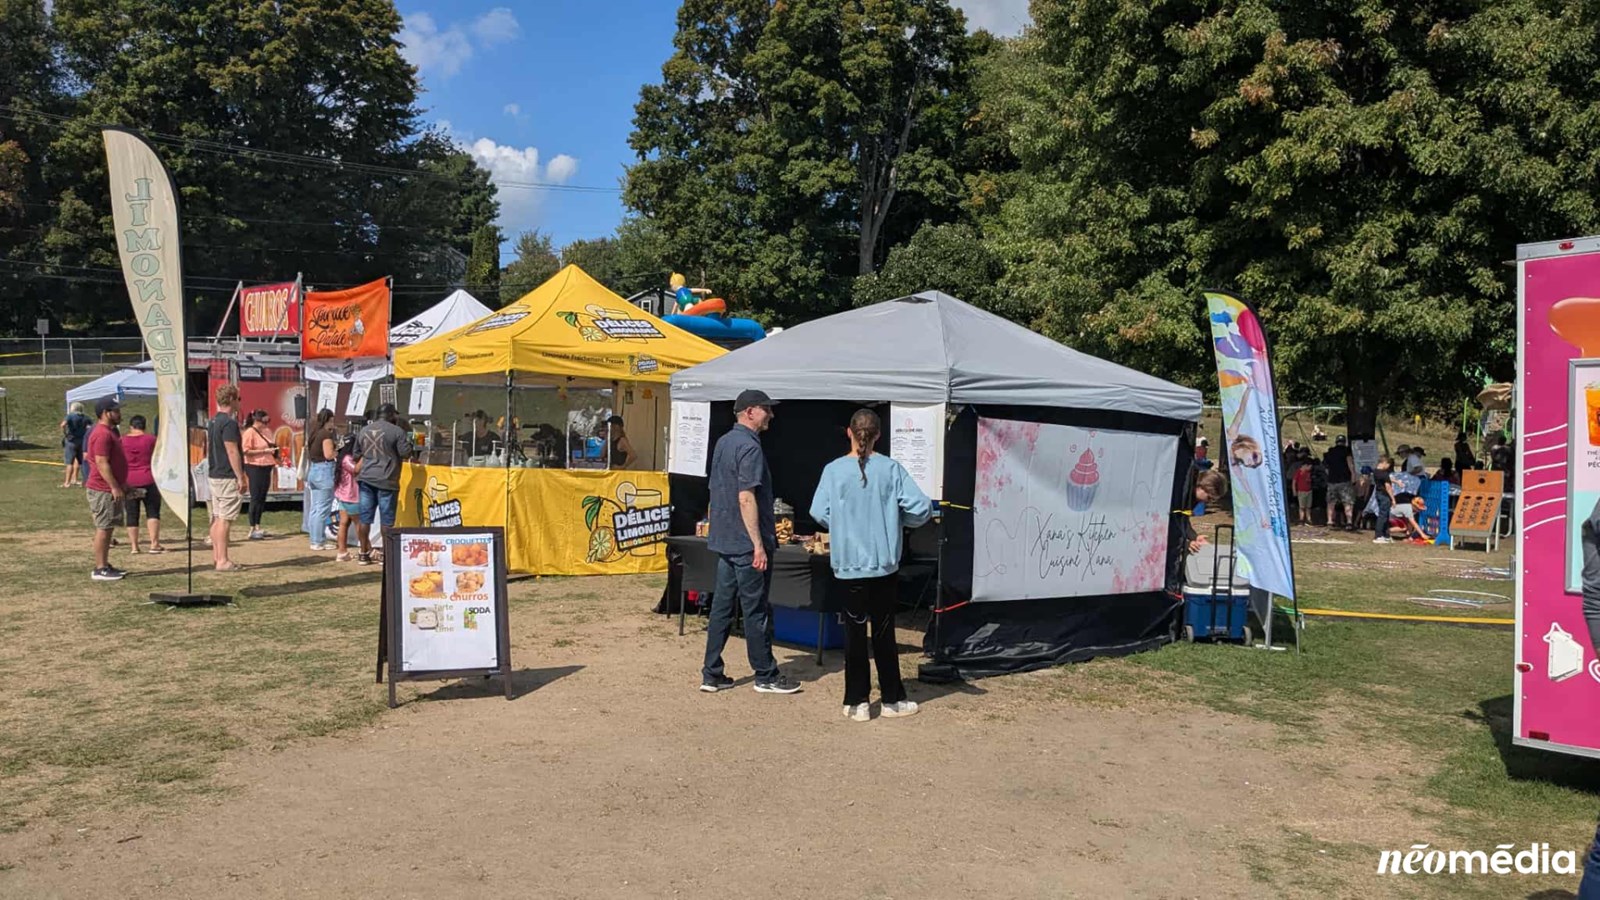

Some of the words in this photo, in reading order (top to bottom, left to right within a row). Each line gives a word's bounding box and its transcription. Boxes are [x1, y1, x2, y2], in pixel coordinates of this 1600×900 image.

[595, 316, 652, 328] DÉLICES
[429, 501, 461, 522] DÉLICES
[614, 507, 670, 529] DÉLICE
[616, 522, 669, 542] LIMONAD
[449, 591, 489, 601] churros
[468, 607, 491, 615] SODA
